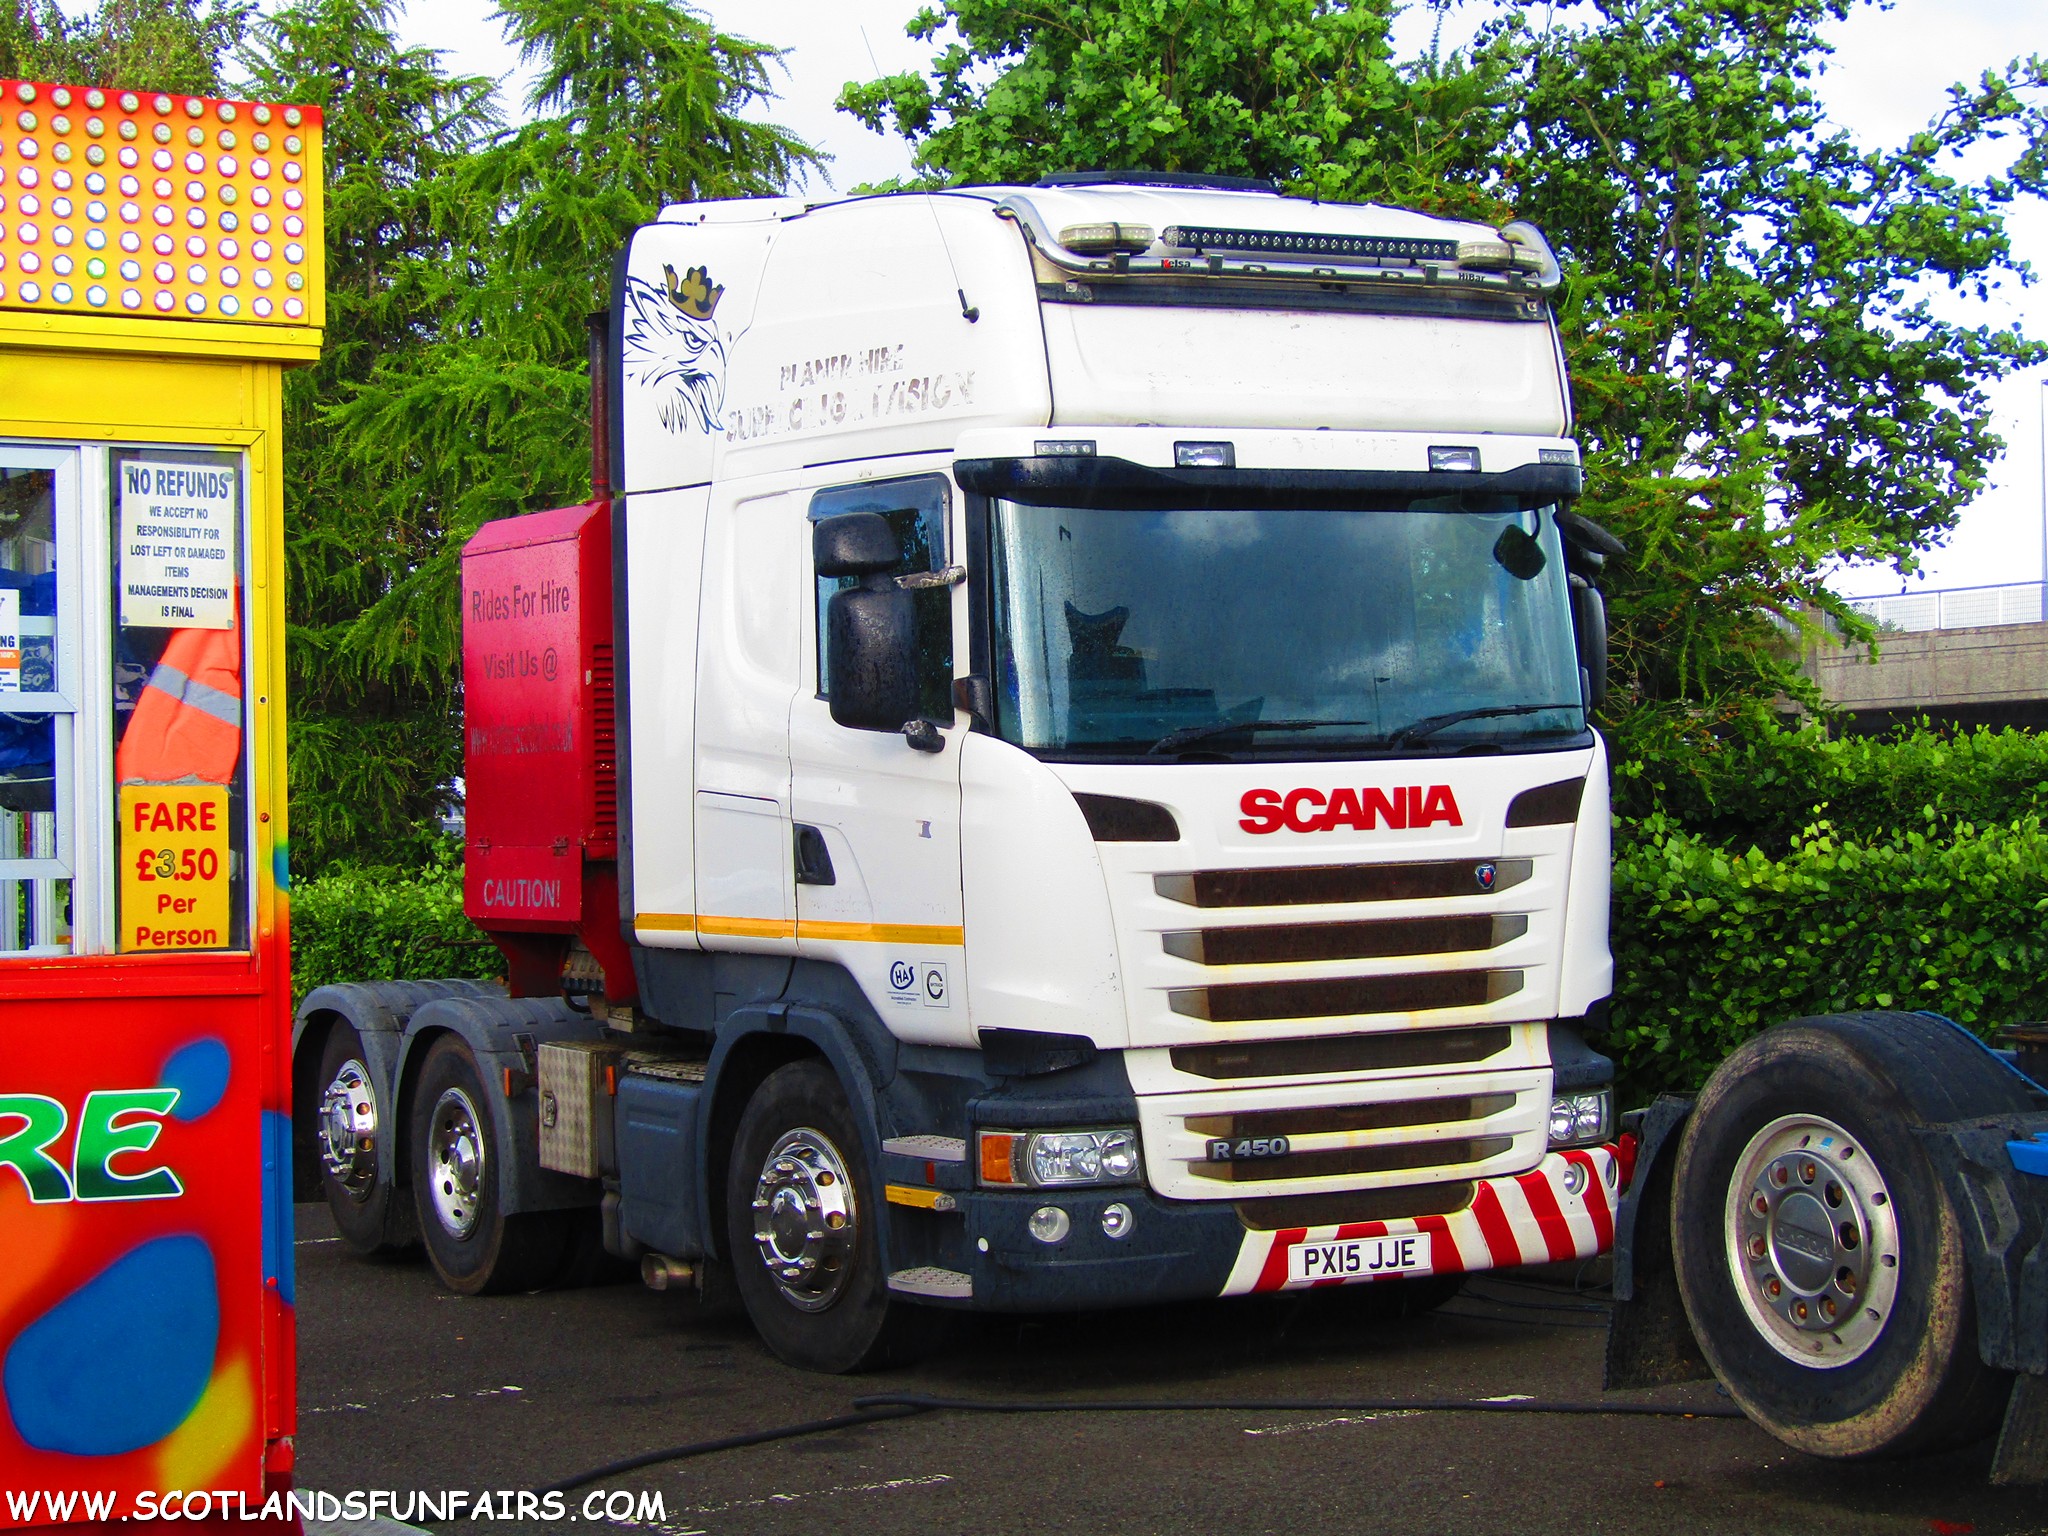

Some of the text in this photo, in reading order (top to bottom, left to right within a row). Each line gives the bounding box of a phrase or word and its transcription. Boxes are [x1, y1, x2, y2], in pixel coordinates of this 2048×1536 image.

[1161, 258, 1191, 269] Kelsa
[128, 468, 229, 499] NO REFUNDS
[150, 506, 208, 520] WE ACCEPT NO
[137, 525, 220, 540] RESPONSIBILITY FOR
[130, 545, 226, 560] LOST LEFT OR DAMAGED
[164, 566, 189, 578] ITEMS
[128, 584, 228, 600] MANAGEMENTS DECISION
[473, 579, 570, 623] Rides For Hire
[162, 606, 194, 618] IS FINAL
[484, 647, 558, 682] Visit Us @
[134, 802, 216, 832] FARE
[1238, 785, 1463, 834] SCANIA
[136, 848, 218, 881] £3.50
[158, 894, 197, 914] Per
[484, 879, 560, 908] CAUTION!
[136, 926, 216, 946] Person
[890, 961, 914, 990] CHAS
[1213, 1138, 1287, 1159] R 450
[1305, 1239, 1415, 1276] PX15 JJE
